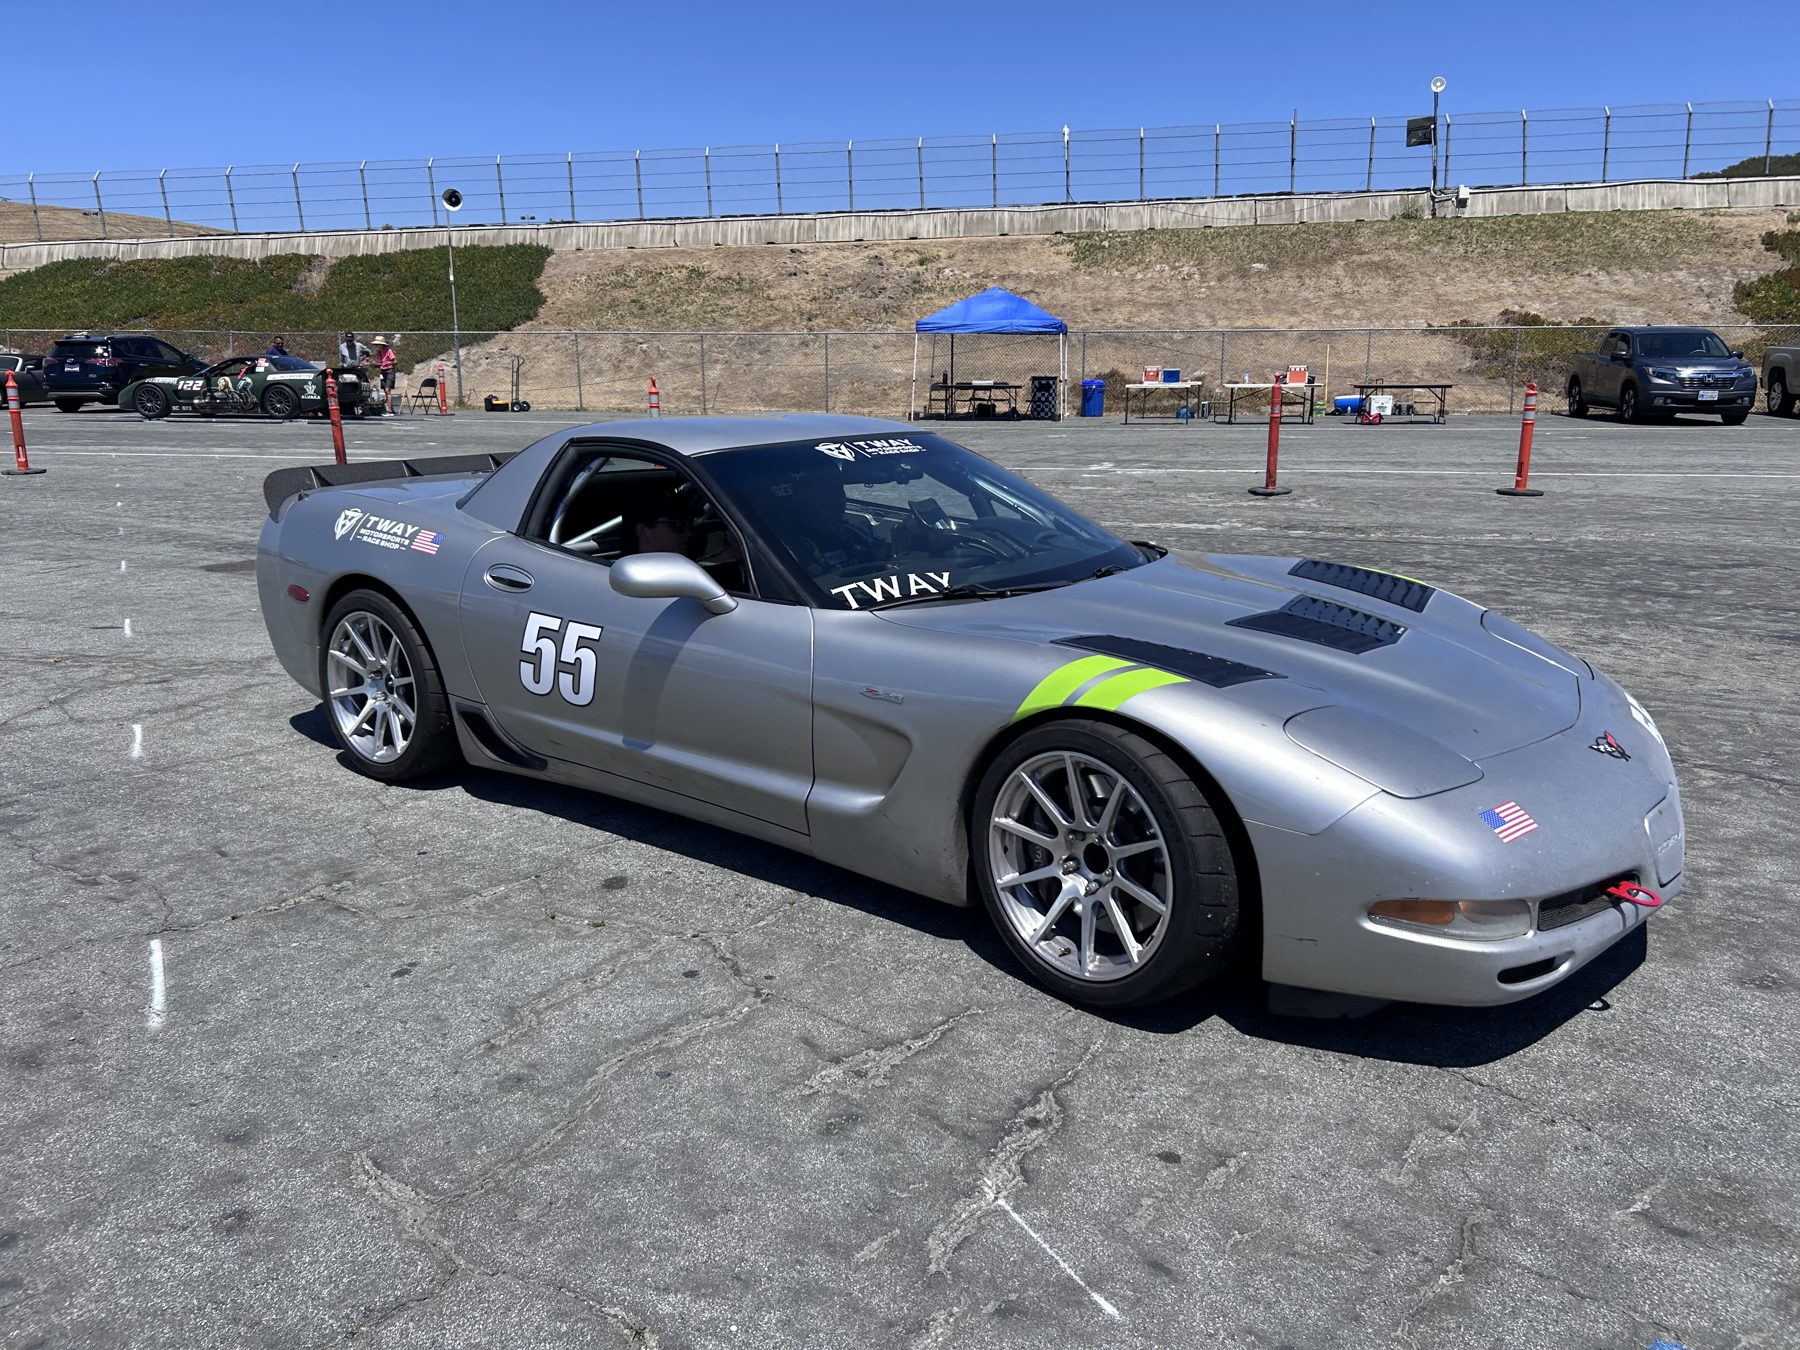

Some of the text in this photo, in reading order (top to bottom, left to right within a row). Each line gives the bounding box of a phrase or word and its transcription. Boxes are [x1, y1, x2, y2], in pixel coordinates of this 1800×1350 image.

[177, 380, 204, 391] 122
[853, 439, 912, 448] TWAY
[366, 516, 419, 538] TWAY
[359, 528, 410, 545] MOTORSPORTS
[362, 535, 400, 550] RACE SHOP
[830, 571, 950, 610] TWAY
[519, 610, 604, 707] 55
